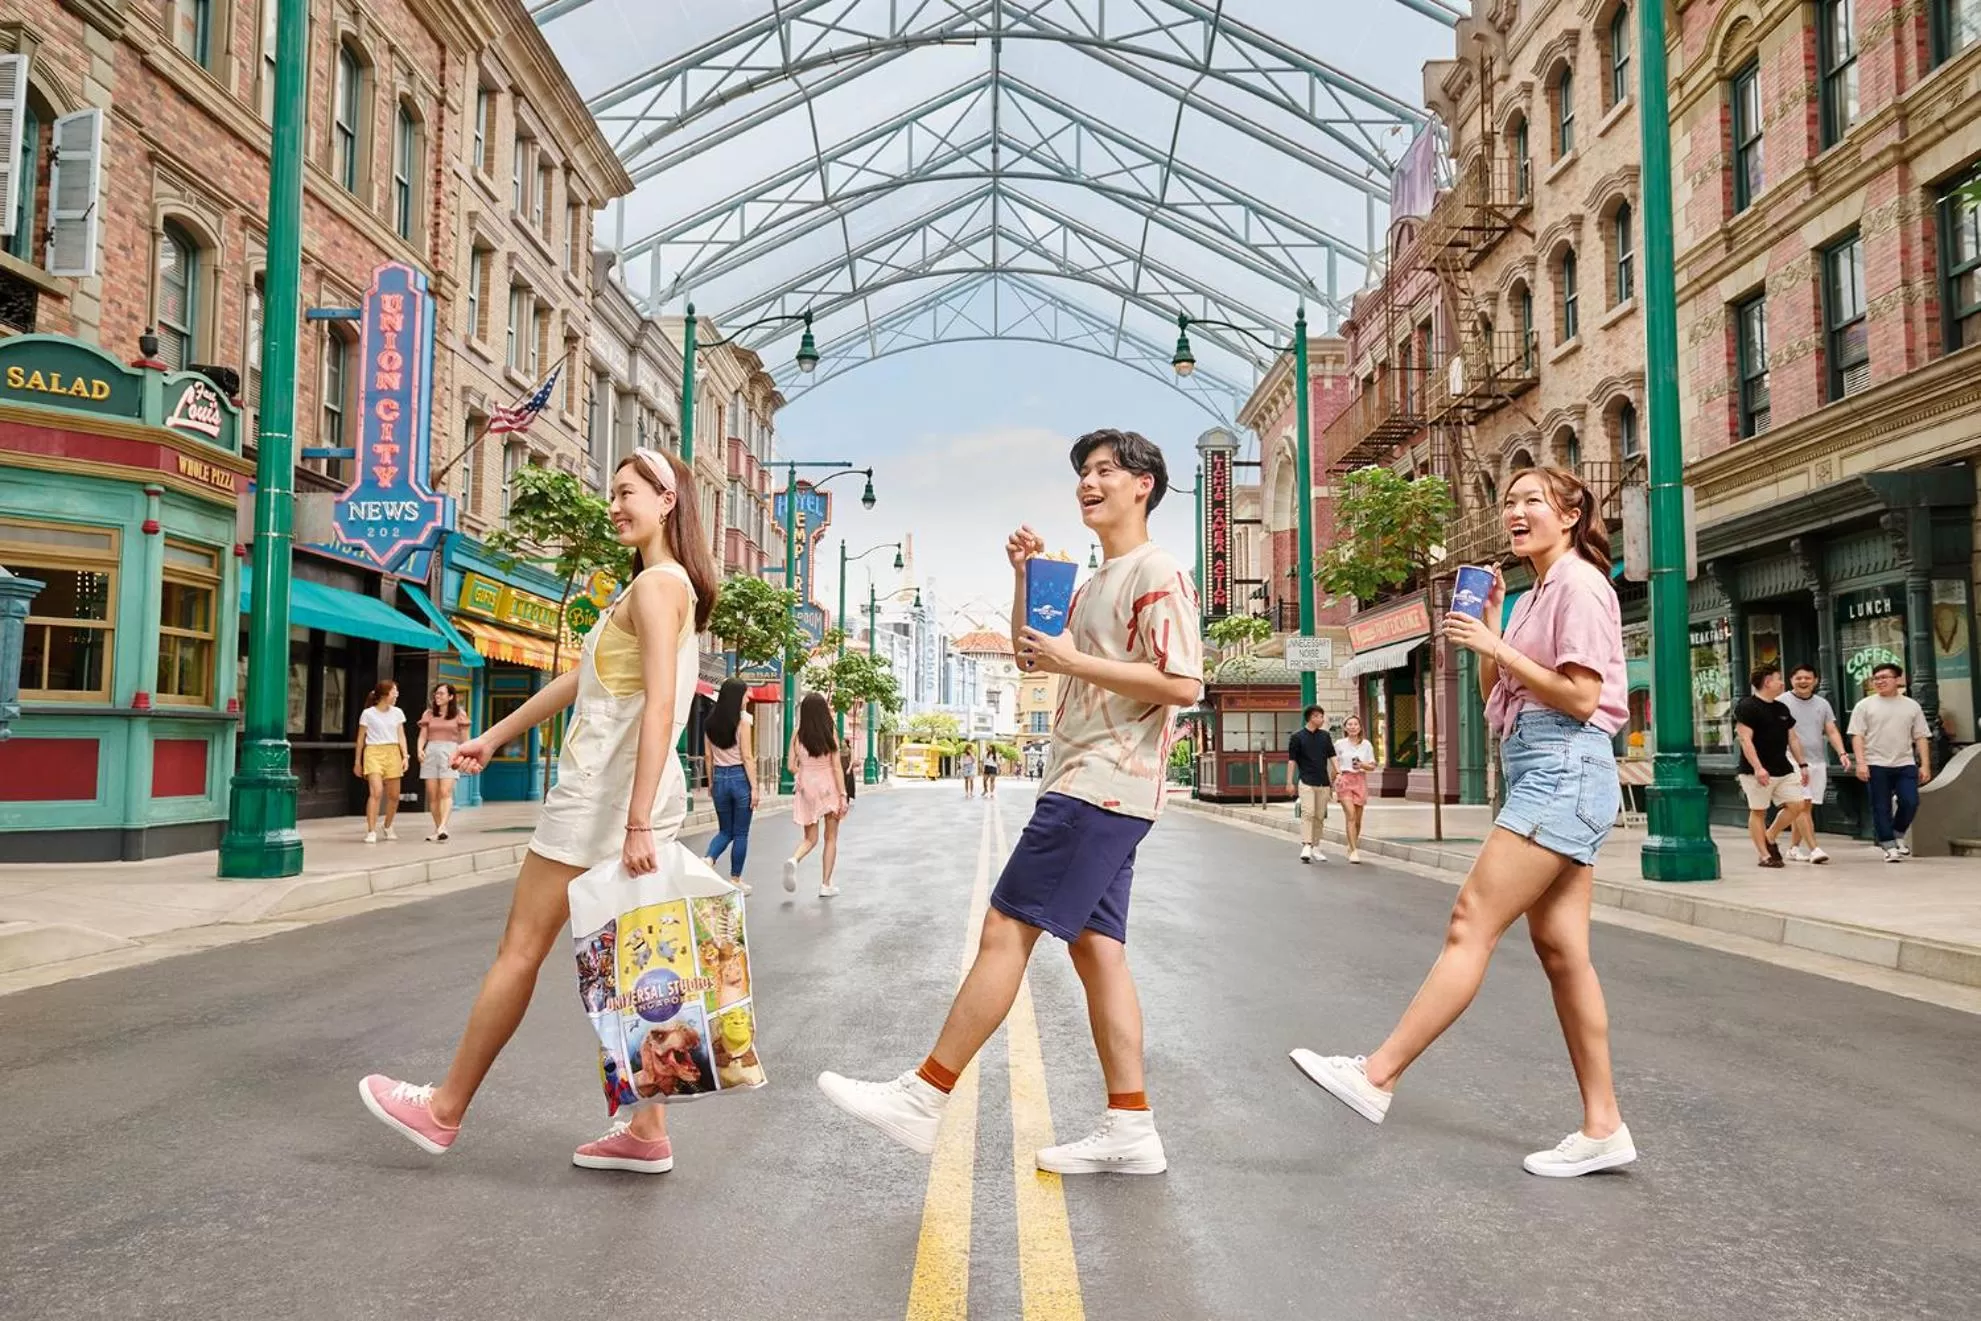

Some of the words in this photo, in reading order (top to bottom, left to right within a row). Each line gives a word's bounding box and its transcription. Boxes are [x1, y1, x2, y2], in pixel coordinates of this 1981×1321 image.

[375, 293, 404, 391] UNION
[7, 366, 111, 400] SALAD
[371, 398, 401, 488] CITY
[179, 454, 209, 482] WHOLE
[211, 467, 236, 492] PIZZA
[1213, 454, 1225, 501] LIGHTS
[348, 500, 420, 522] NEWS
[1213, 507, 1226, 553] CAMERA
[367, 527, 400, 537] 202
[795, 512, 806, 607] EMPIRE
[1213, 559, 1225, 605] ACTION
[1849, 598, 1892, 619] LUNCH
[1846, 647, 1901, 674] COFFEE
[606, 982, 664, 1011] UNIVERSAL
[667, 975, 716, 996] STUDIOS
